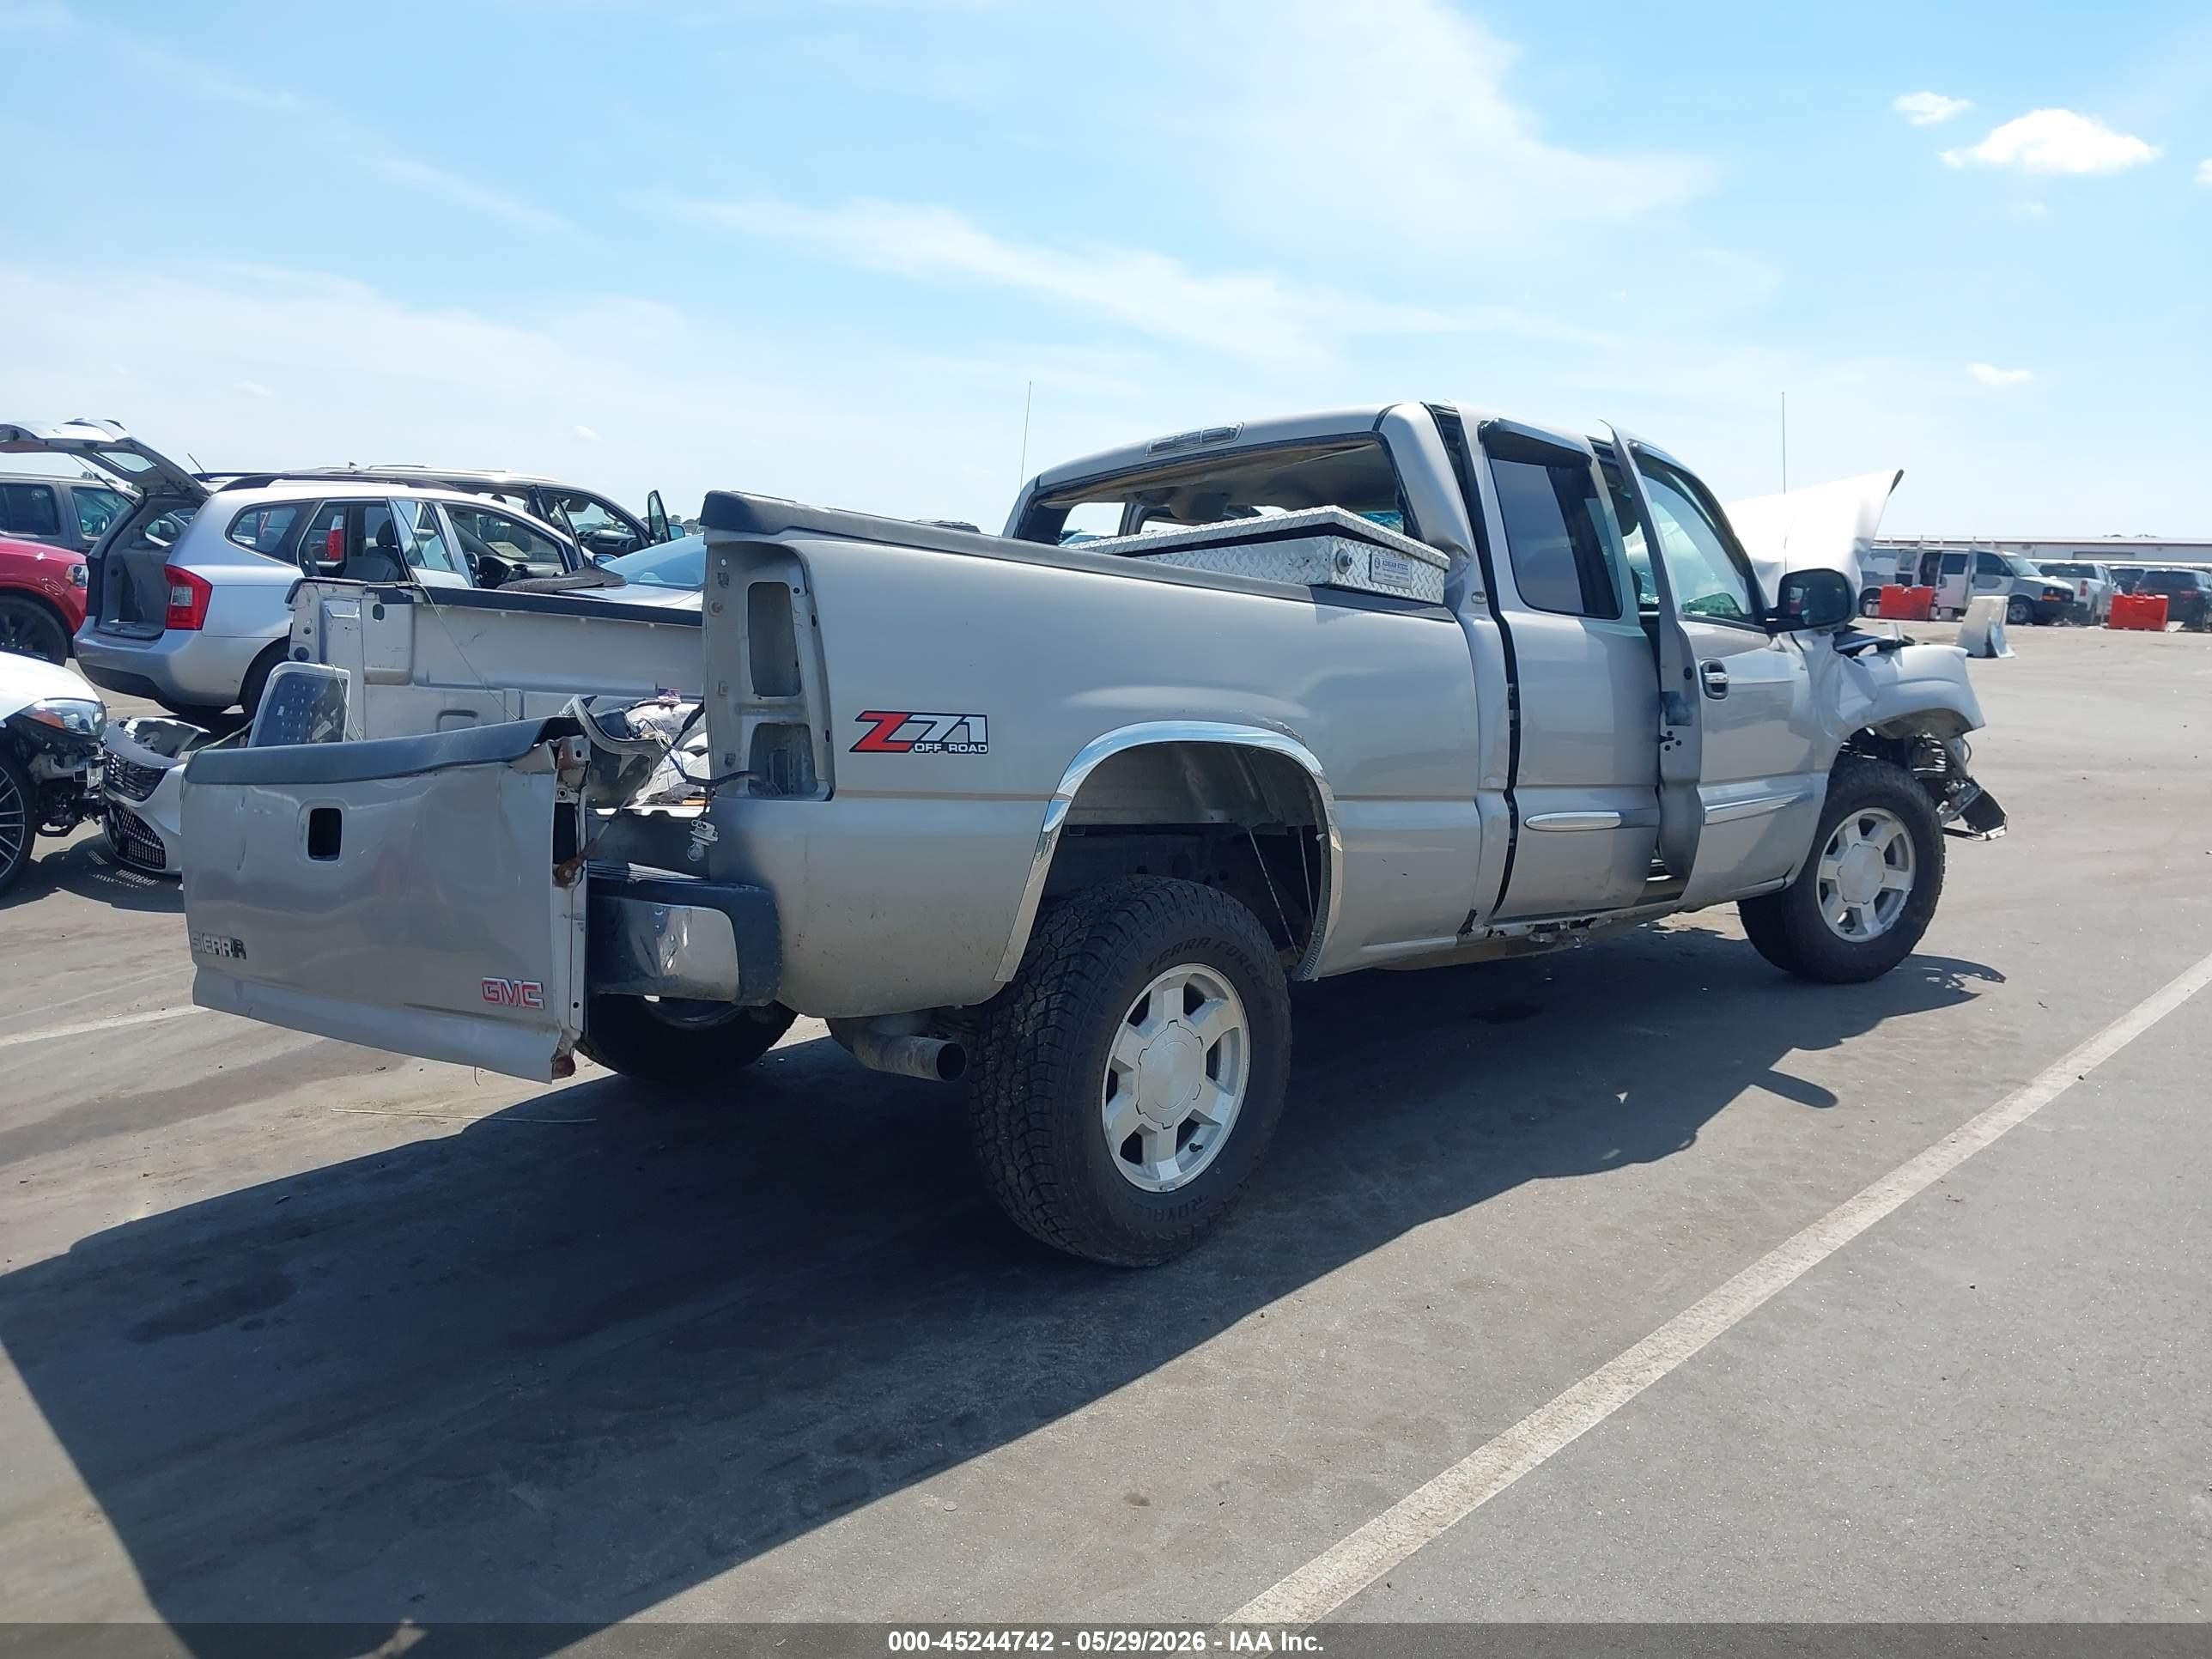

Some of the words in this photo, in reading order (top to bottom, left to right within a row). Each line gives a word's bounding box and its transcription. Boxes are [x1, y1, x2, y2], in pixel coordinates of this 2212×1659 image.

[848, 710, 988, 753] Z71
[914, 743, 942, 753] OFF
[948, 744, 988, 753] ROAD
[481, 976, 545, 1010] GMC
